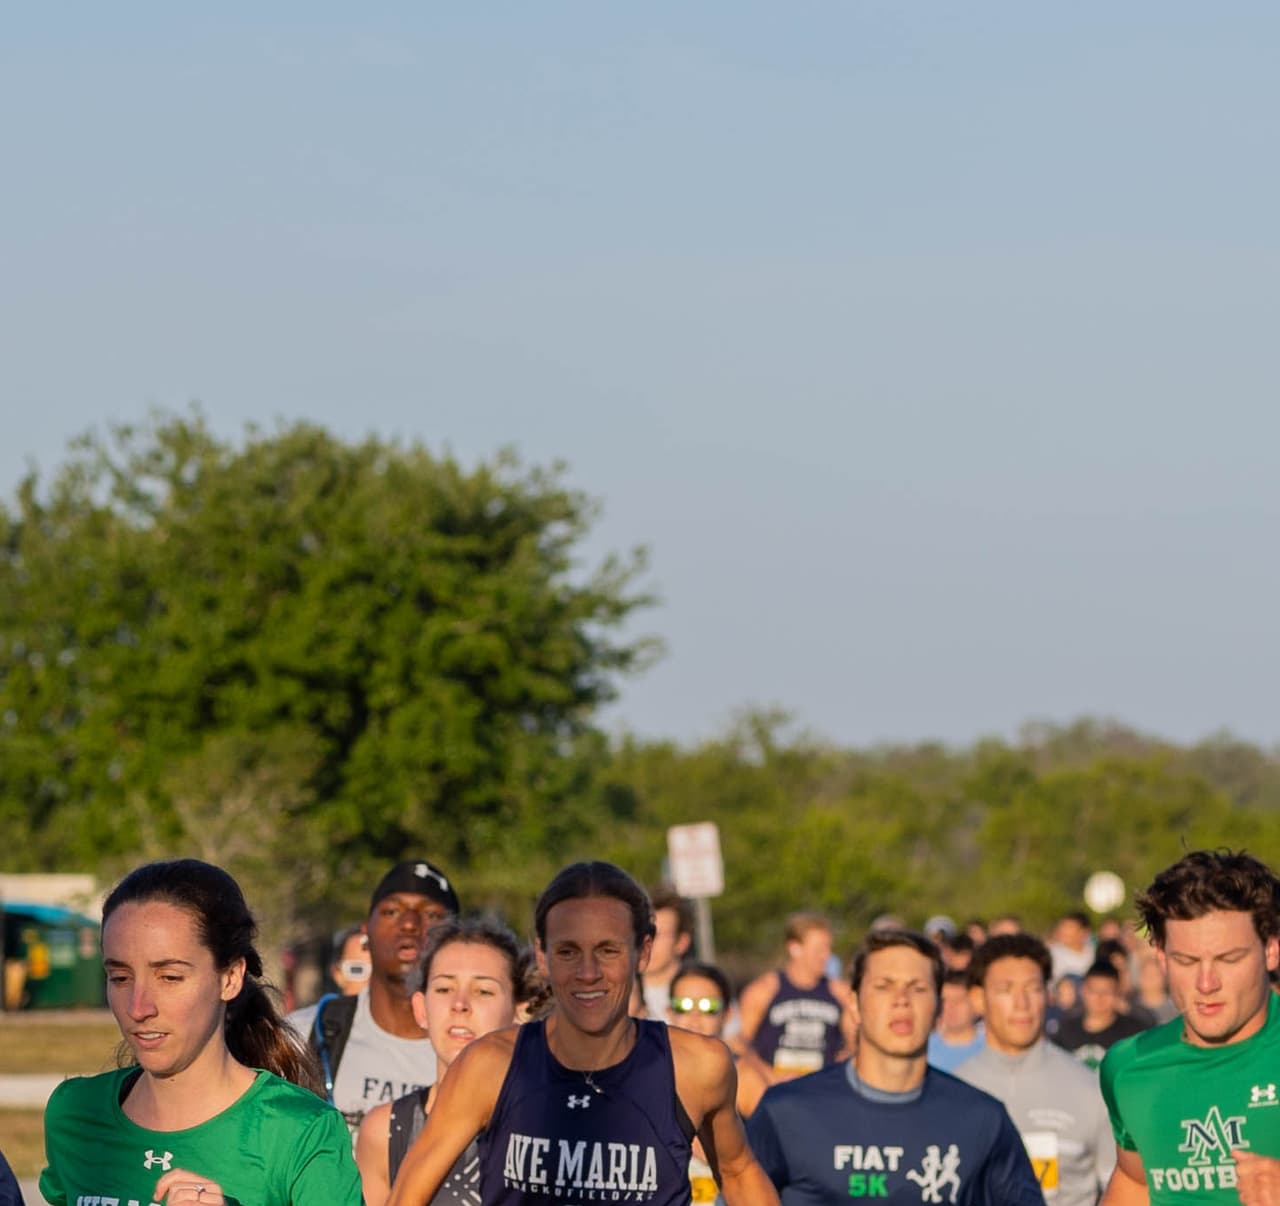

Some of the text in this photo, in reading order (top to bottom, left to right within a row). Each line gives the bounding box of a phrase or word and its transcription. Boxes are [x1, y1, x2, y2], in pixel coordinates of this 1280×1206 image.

[503, 1133, 551, 1185] AVE
[555, 1139, 659, 1192] MARIA
[833, 1144, 905, 1172] FIAT
[847, 1173, 889, 1198] 5K
[1149, 1165, 1239, 1191] FOOTB
